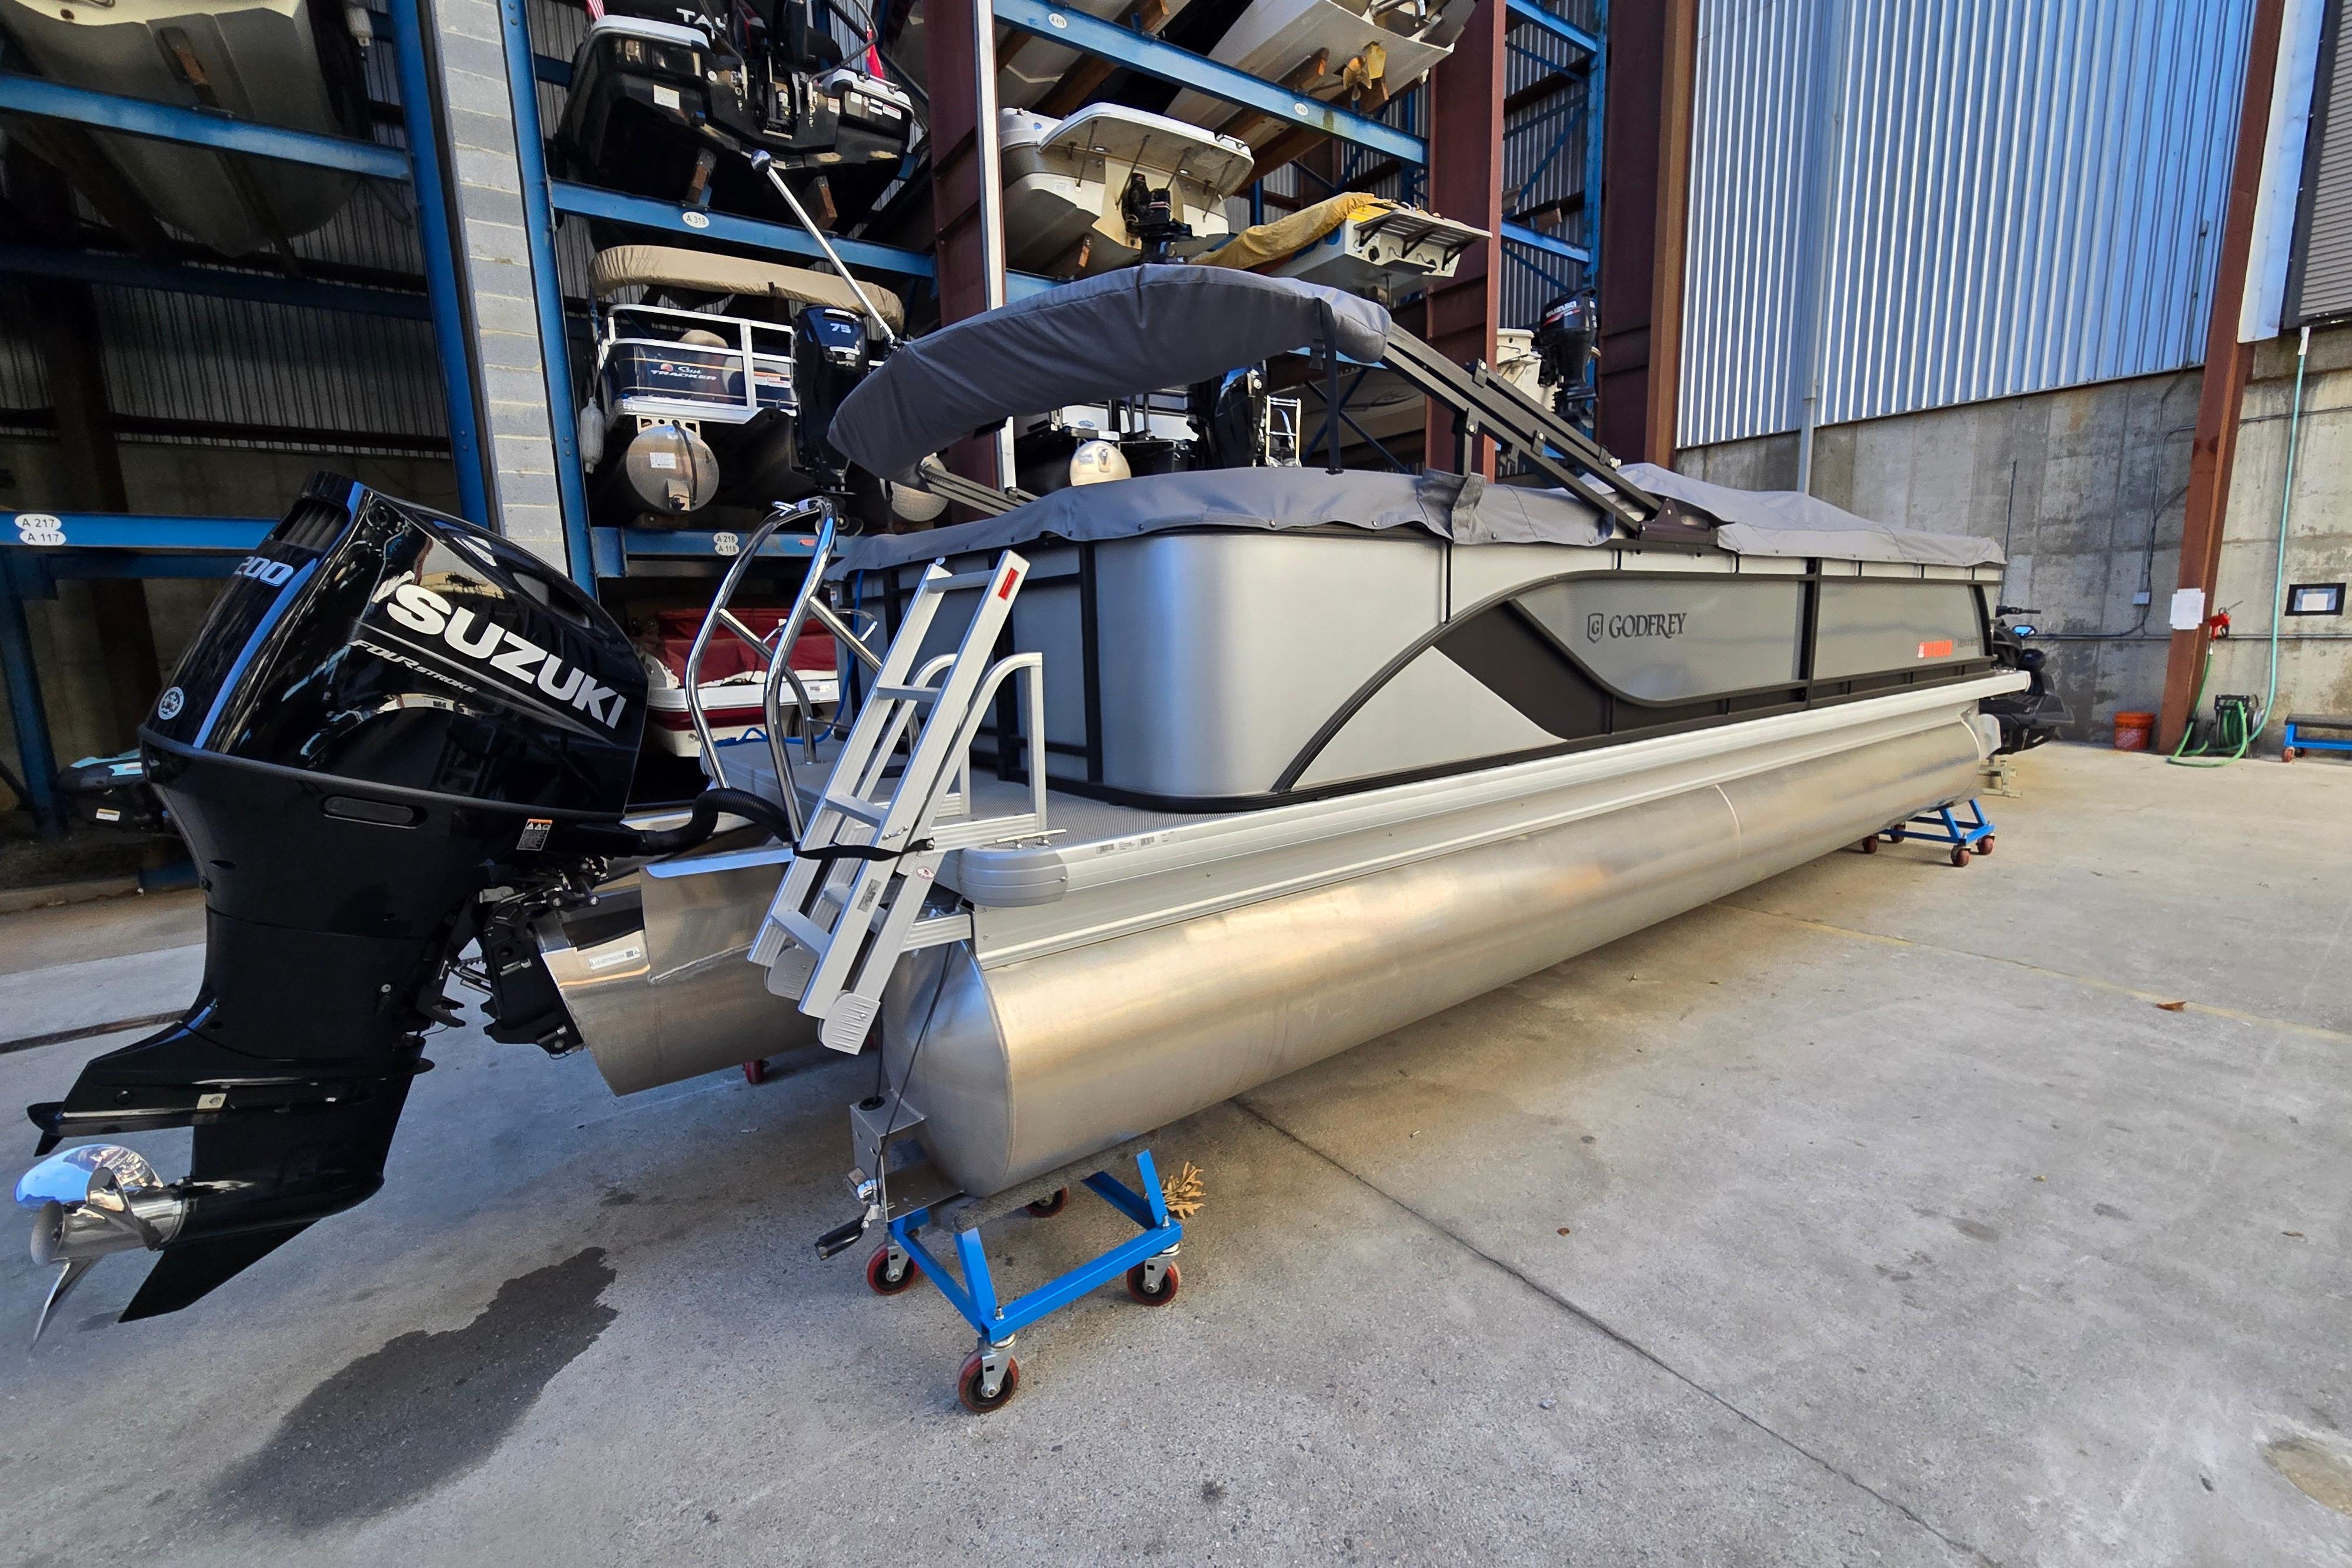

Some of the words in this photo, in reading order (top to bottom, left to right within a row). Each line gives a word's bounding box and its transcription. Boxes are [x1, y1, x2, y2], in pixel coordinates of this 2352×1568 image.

[694, 216, 706, 225] 318
[830, 323, 851, 333] 75
[650, 369, 717, 380] TRACKER
[22, 518, 31, 527] A
[34, 519, 55, 528] 217
[27, 533, 36, 542] A
[41, 533, 59, 543] 117
[233, 556, 293, 587] 200
[1609, 613, 1688, 639] GODFREY
[387, 584, 627, 729] SUZUKI
